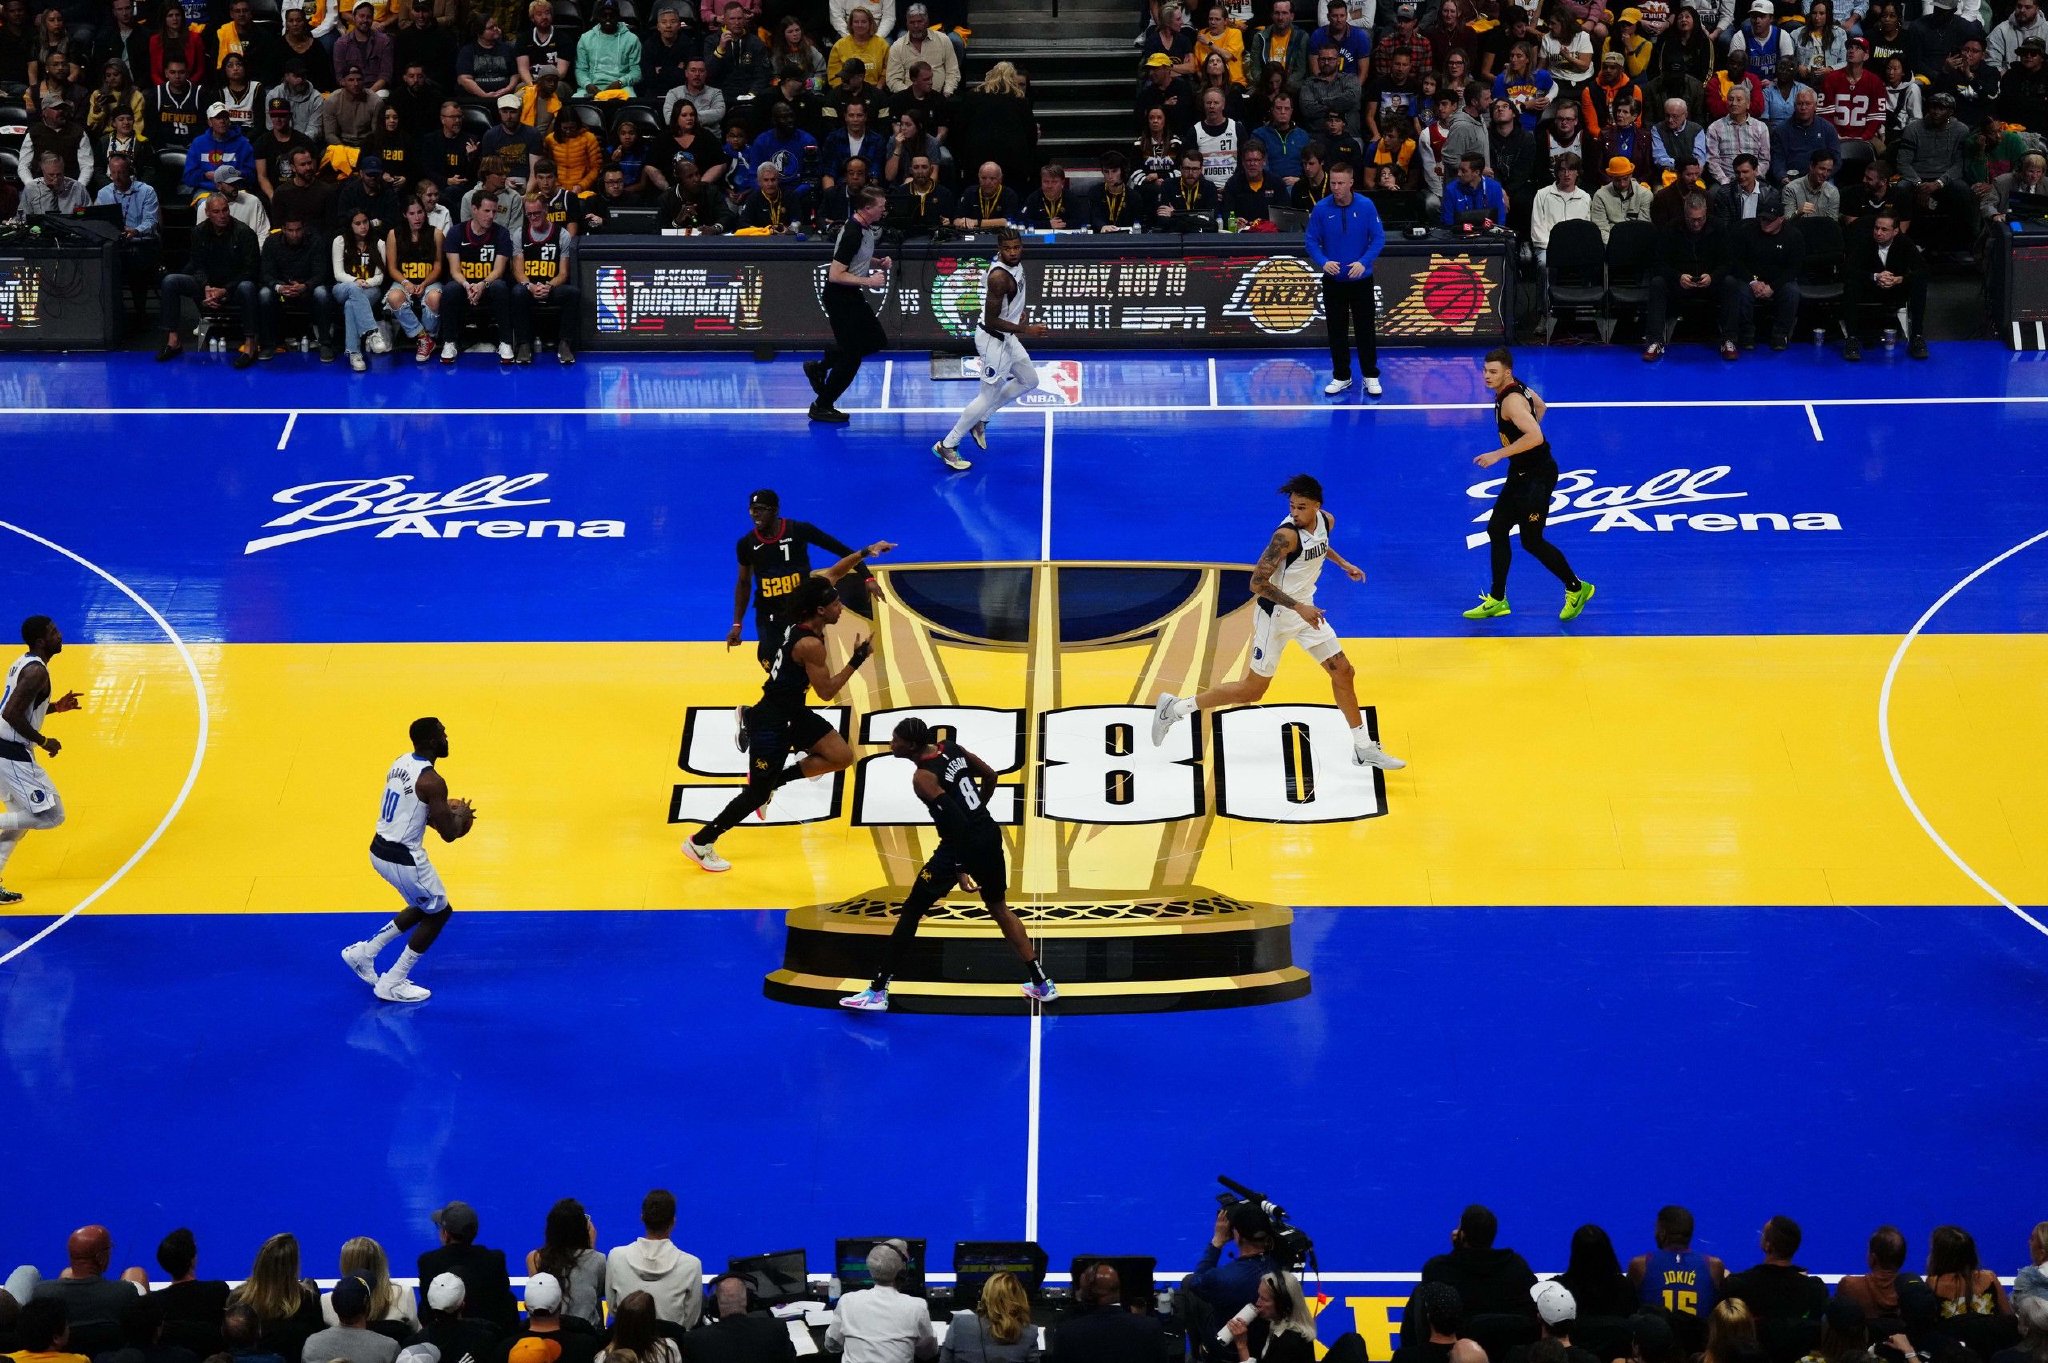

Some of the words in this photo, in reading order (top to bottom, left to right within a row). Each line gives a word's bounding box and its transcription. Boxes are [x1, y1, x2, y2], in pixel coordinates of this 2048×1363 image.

[161, 111, 198, 124] DENVER
[1834, 94, 1869, 126] 52
[1220, 140, 1232, 151] 27
[1203, 166, 1235, 176] NUGGETS
[480, 248, 496, 262] 27
[541, 246, 557, 260] 27
[460, 261, 493, 279] 5280
[524, 259, 557, 278] 5280
[1042, 264, 1113, 300] FRIDAY,
[1117, 264, 1162, 297] NOV
[1165, 263, 1188, 296] 10
[630, 281, 742, 323] TOURNAMENT
[1093, 304, 1113, 329] ET
[1121, 306, 1207, 329] ESPN
[1026, 395, 1057, 403] NBA
[248, 473, 551, 539] Ball
[375, 513, 626, 538] Arena
[1589, 508, 1843, 532] Arena
[779, 543, 790, 561] 7
[668, 703, 1388, 826] 5280
[944, 756, 968, 783] WATSON
[382, 788, 400, 823] 10
[958, 776, 981, 811] 8
[1662, 1289, 1698, 1318] 15
